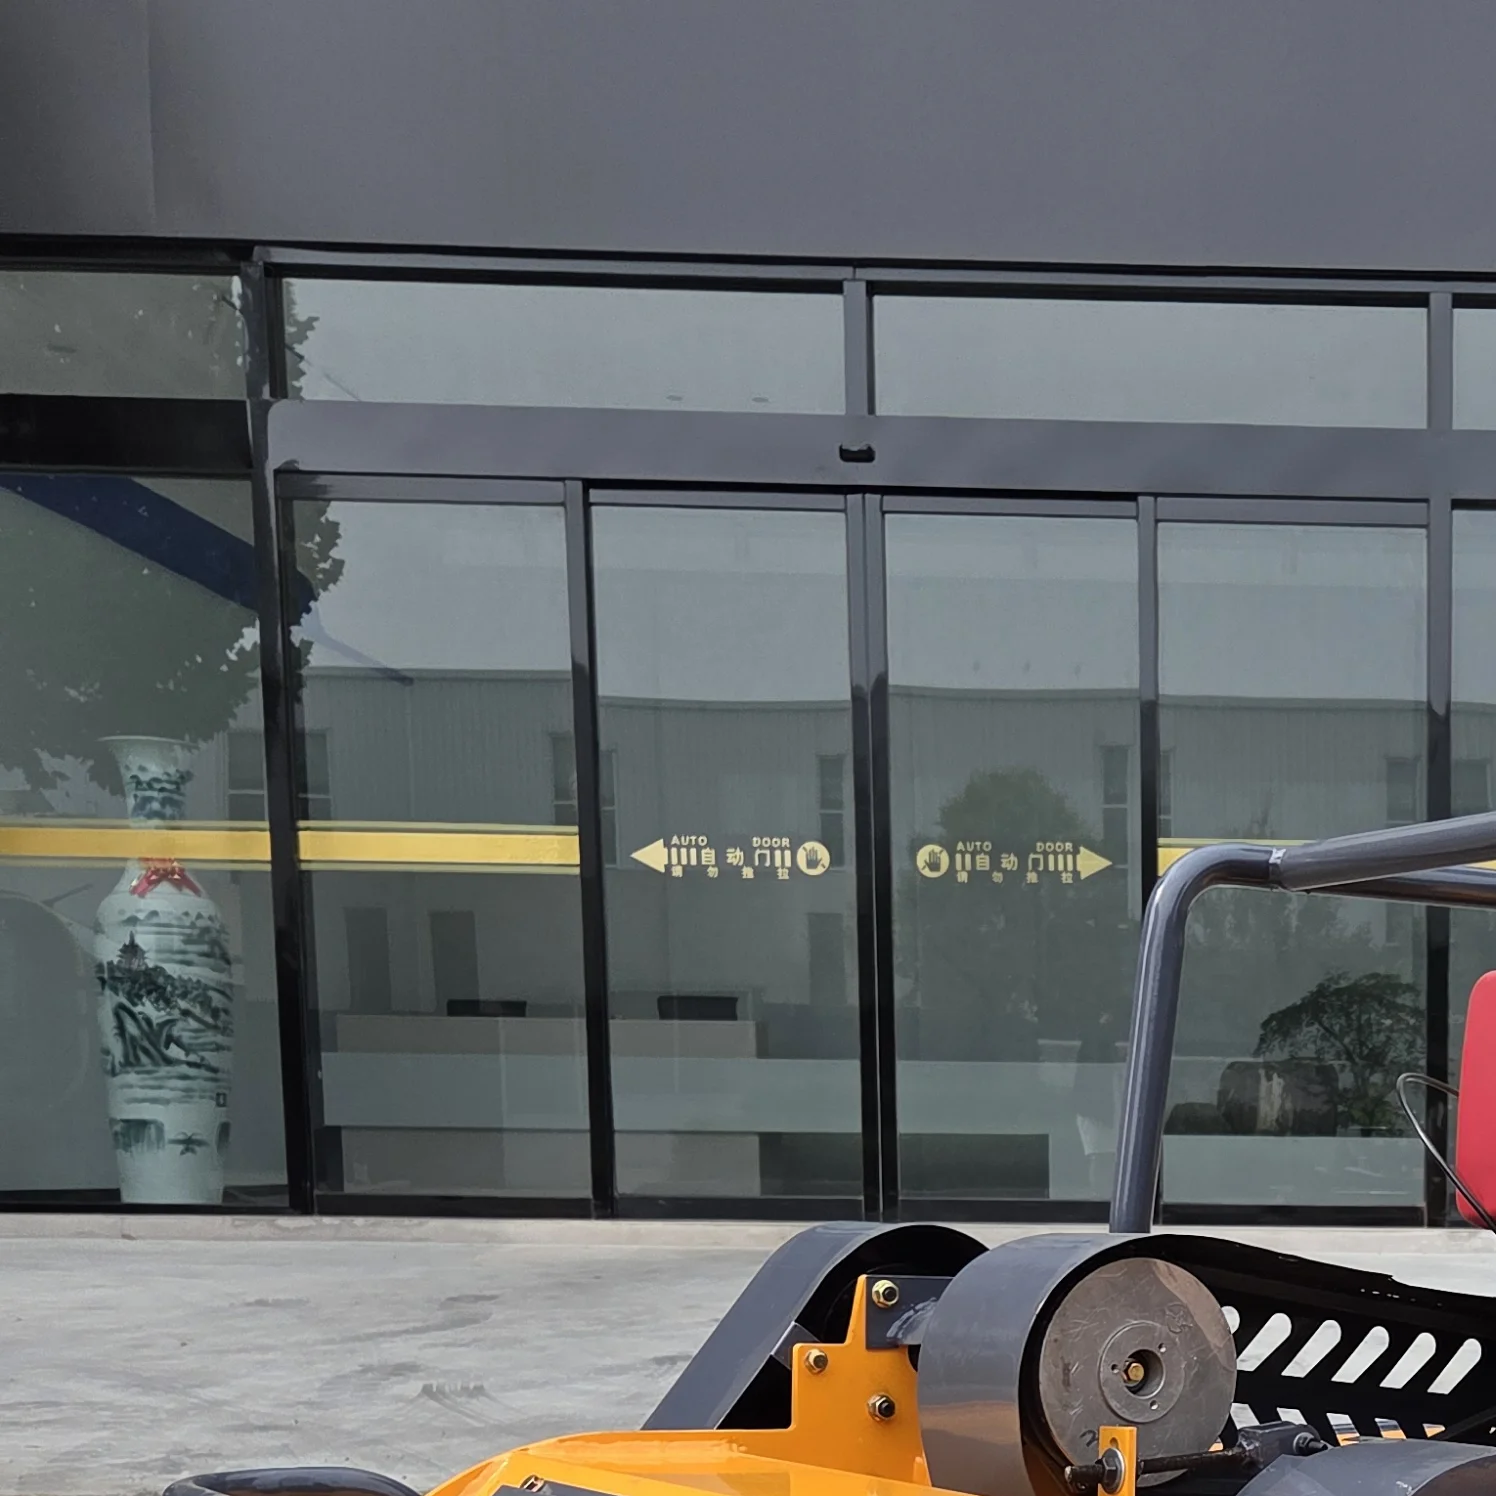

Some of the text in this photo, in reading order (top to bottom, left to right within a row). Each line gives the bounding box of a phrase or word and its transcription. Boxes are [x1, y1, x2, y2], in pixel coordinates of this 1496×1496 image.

[671, 835, 790, 848] AUTO DOOR
[956, 841, 1074, 852] AUTO DOOR
[701, 847, 770, 867] 自动门
[976, 852, 1044, 871] 自动门
